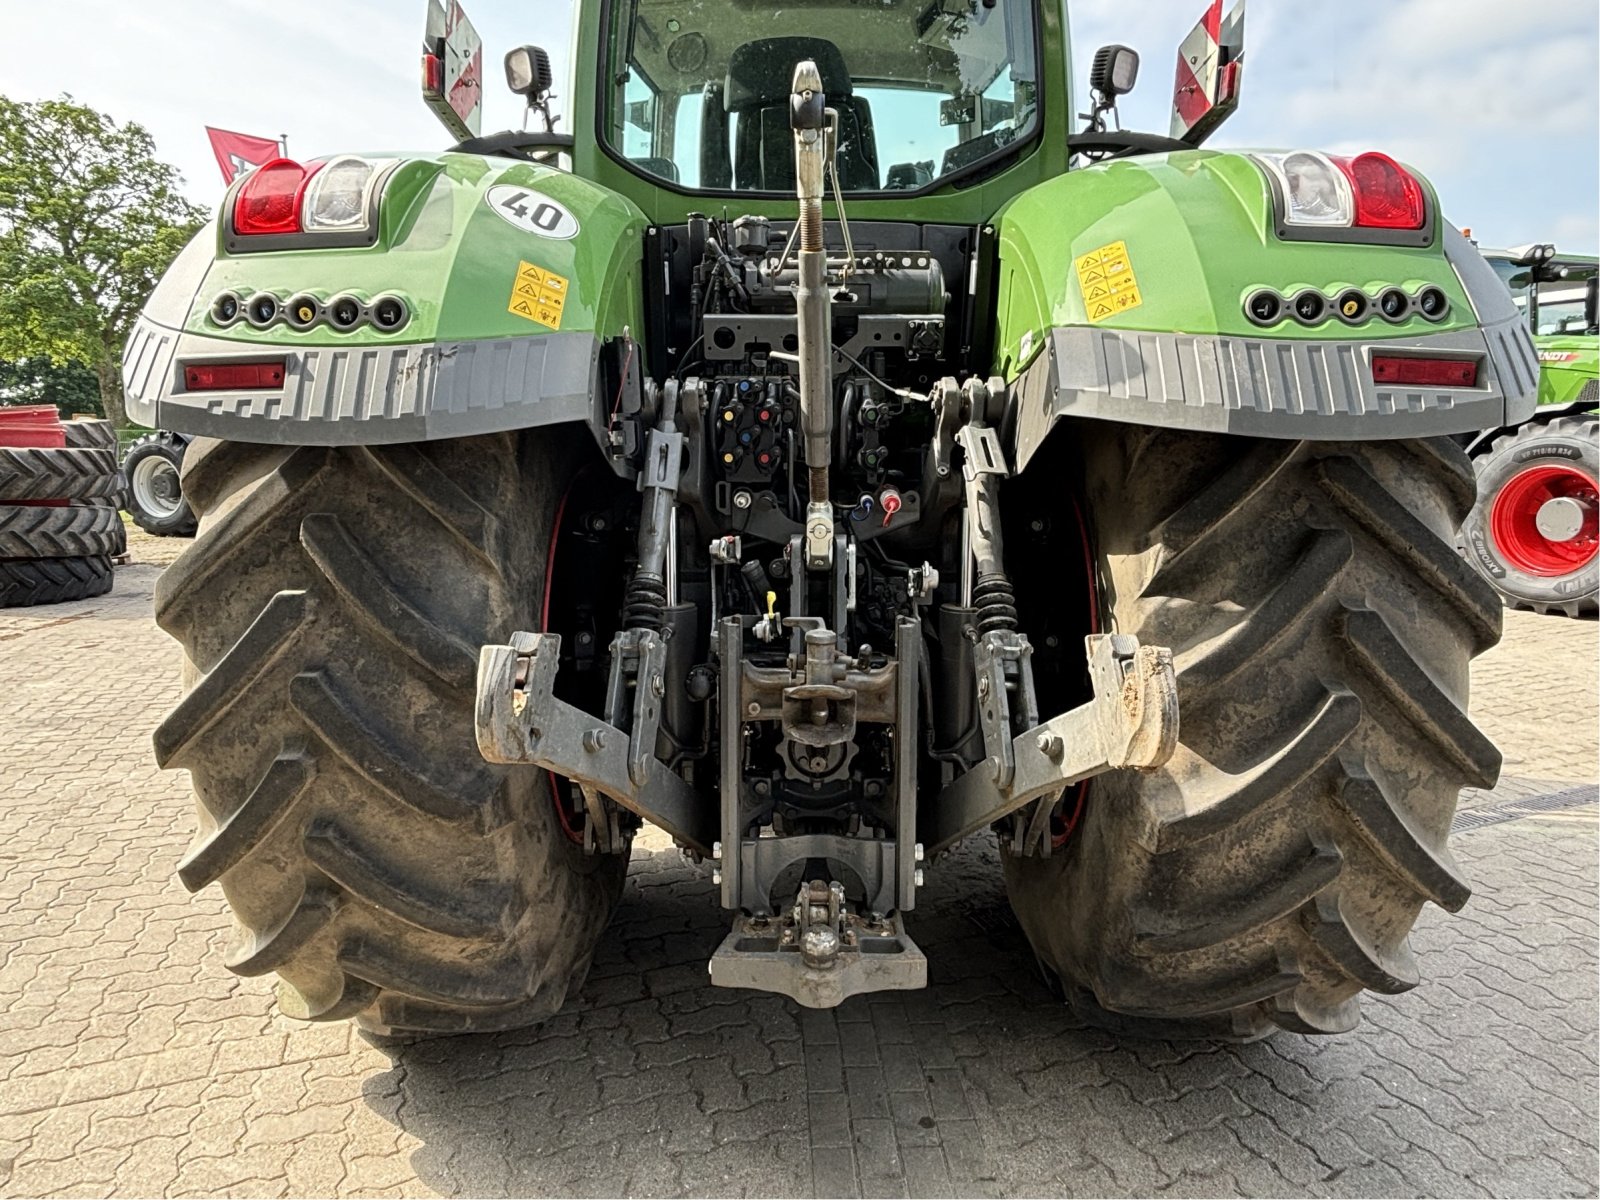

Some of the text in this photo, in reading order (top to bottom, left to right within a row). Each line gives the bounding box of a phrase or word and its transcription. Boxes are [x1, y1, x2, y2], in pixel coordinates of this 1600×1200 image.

[501, 192, 563, 231] 40
[1471, 530, 1502, 573] AXIOBIB 2
